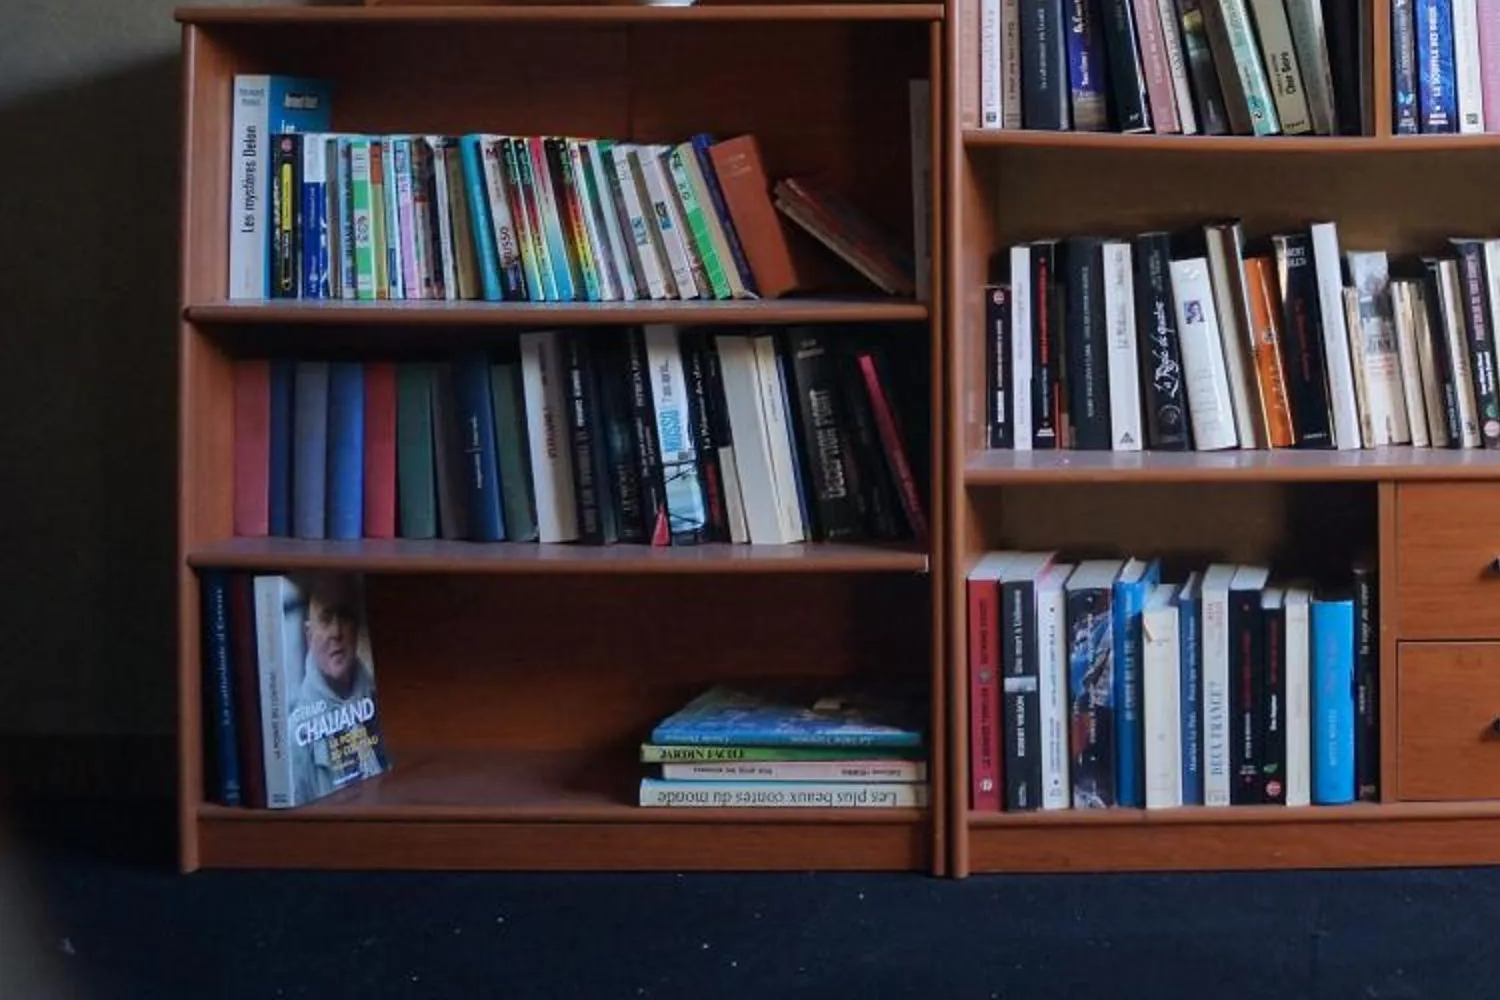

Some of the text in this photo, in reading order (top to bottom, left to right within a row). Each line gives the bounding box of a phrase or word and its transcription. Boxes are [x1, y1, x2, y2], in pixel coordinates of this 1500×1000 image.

[242, 125, 257, 158] Delon
[240, 214, 256, 233] Les
[658, 409, 683, 453] MUSSO
[295, 696, 375, 747] CHALIAND
[655, 788, 897, 806] Les plus beaux contes du monde
